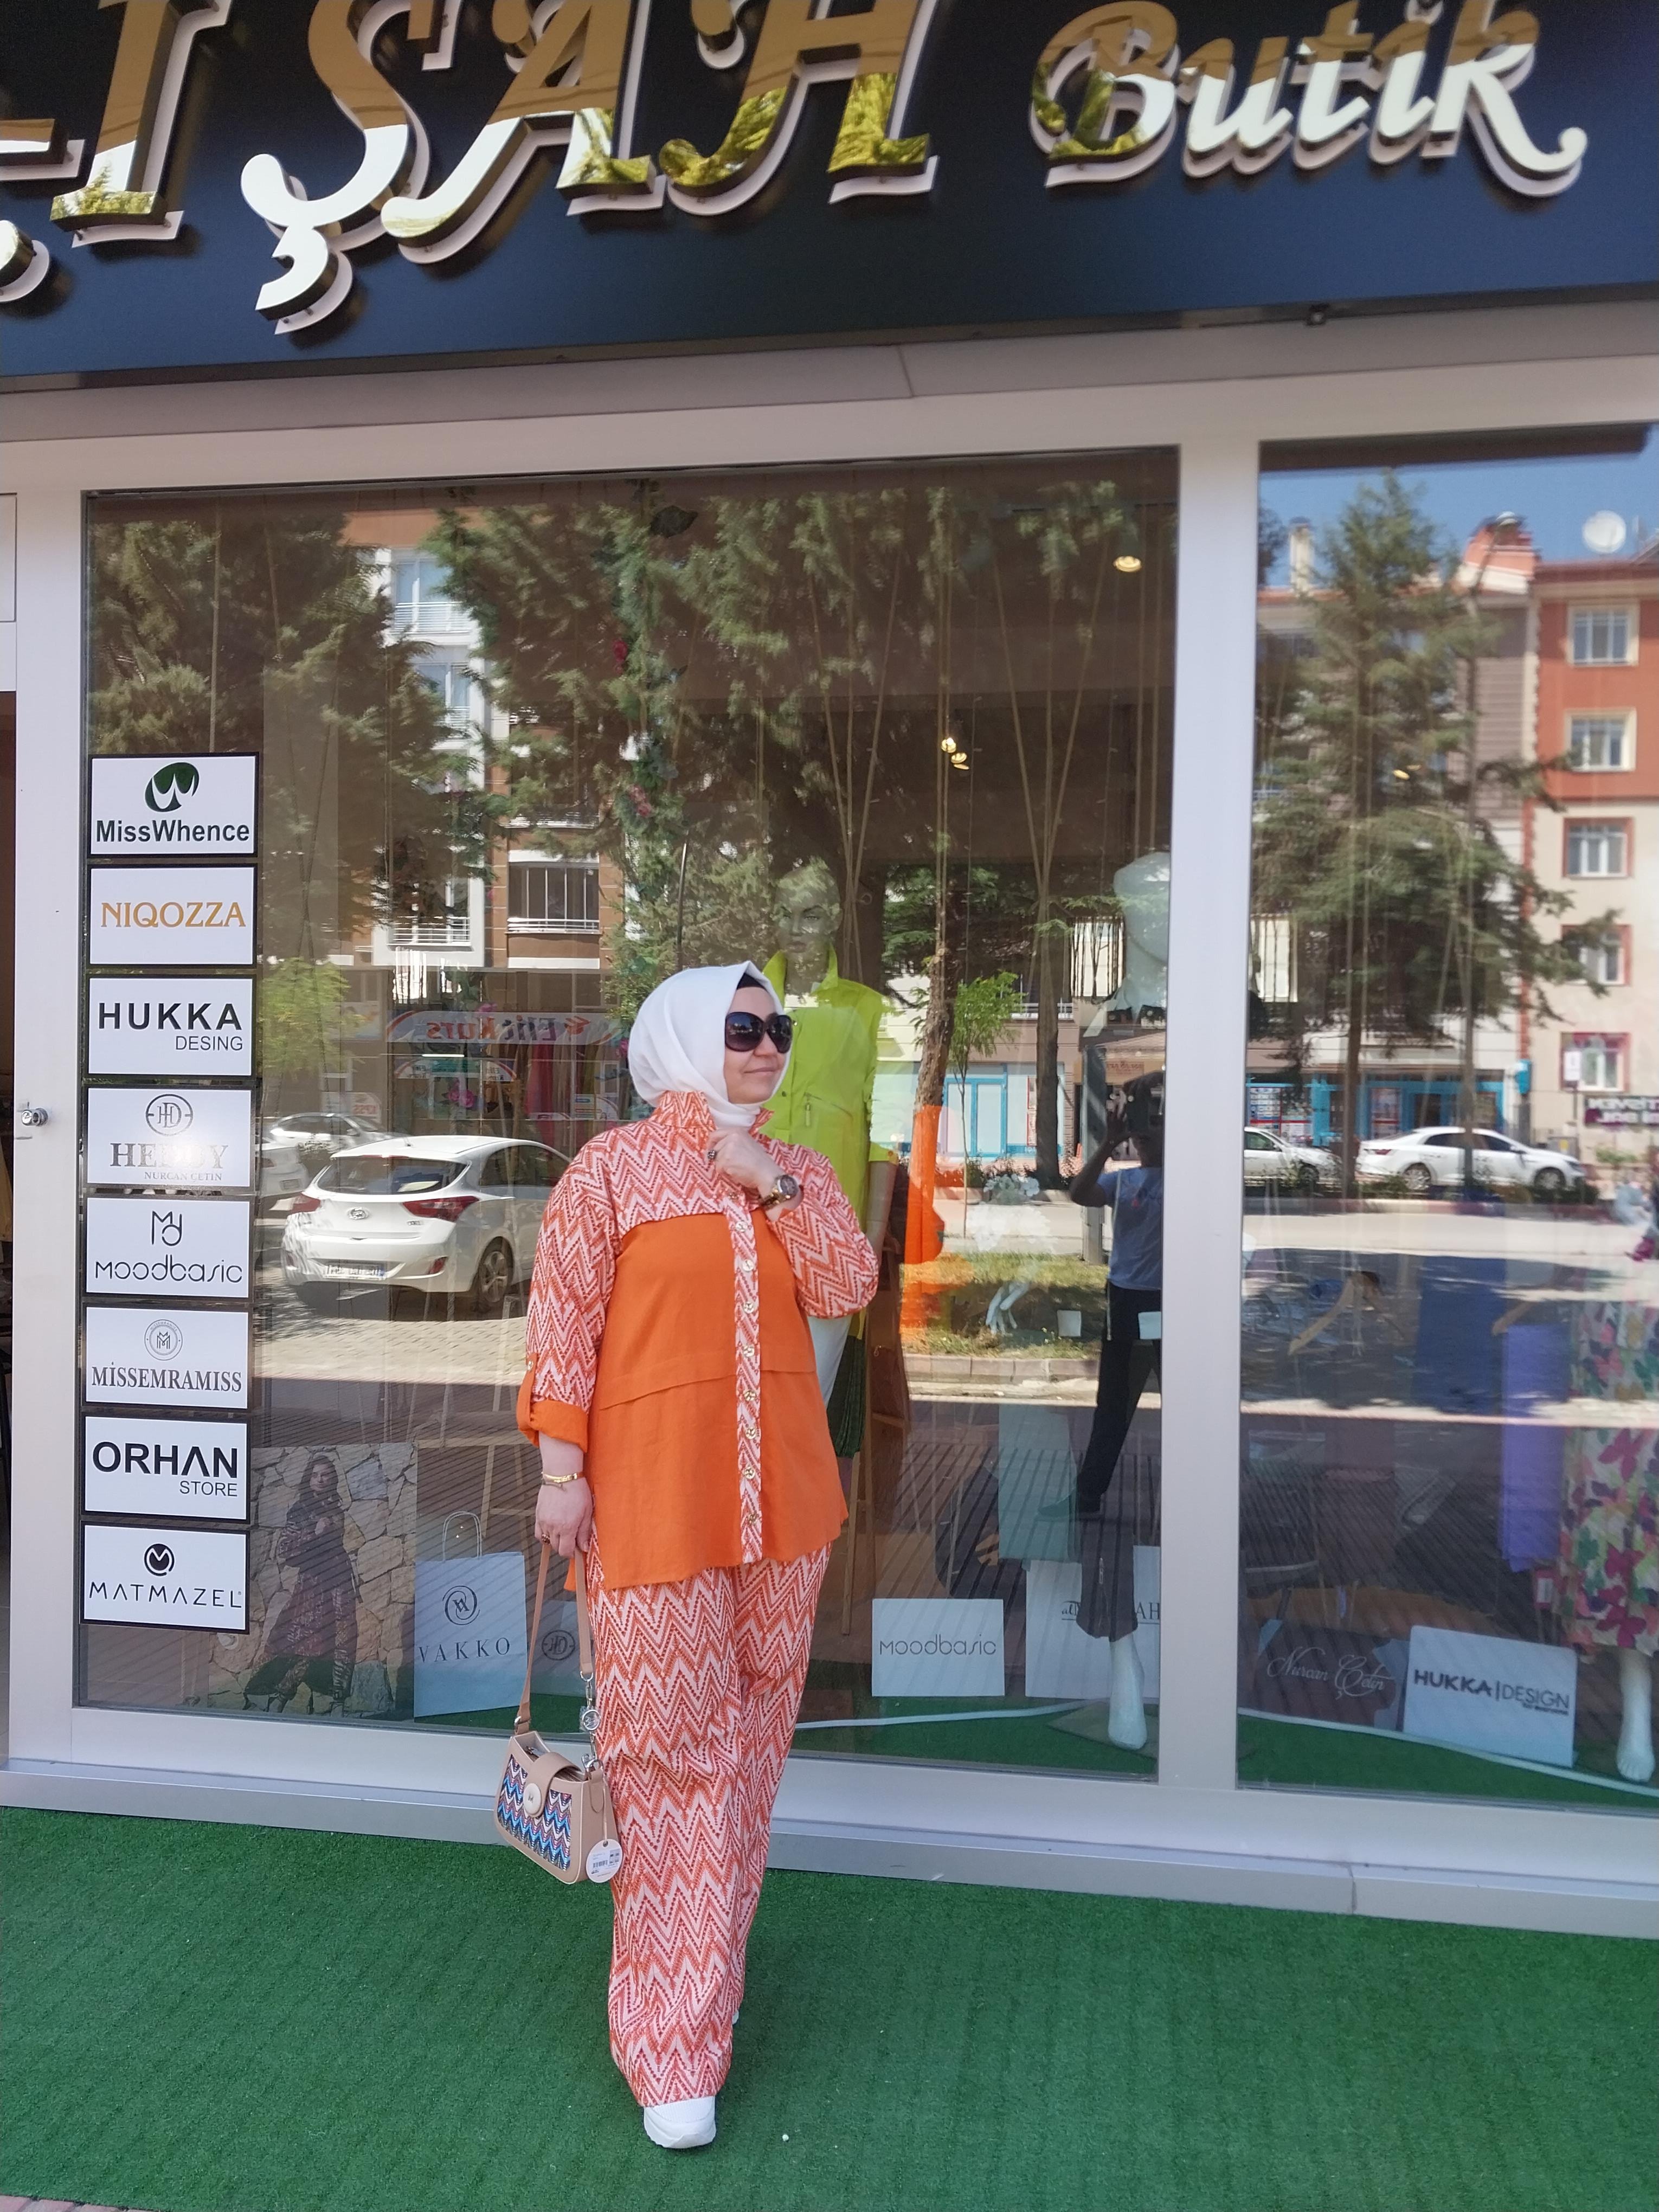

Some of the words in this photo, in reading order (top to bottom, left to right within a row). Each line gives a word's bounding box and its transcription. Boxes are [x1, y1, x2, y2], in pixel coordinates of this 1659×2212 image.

[0, 0, 935, 335] IŞAH
[1029, 0, 1589, 196] Butik
[96, 820, 250, 843] MissWhence
[100, 902, 246, 928] NIQOZZA
[99, 1002, 242, 1031] HUKKA
[175, 1036, 243, 1051] DESING
[95, 1254, 243, 1283] Moodbasic
[92, 1441, 237, 1478] ORHAN
[179, 1481, 237, 1497] STORE
[419, 1637, 510, 1663] VAKKO
[879, 1634, 996, 1655] Moodbasic
